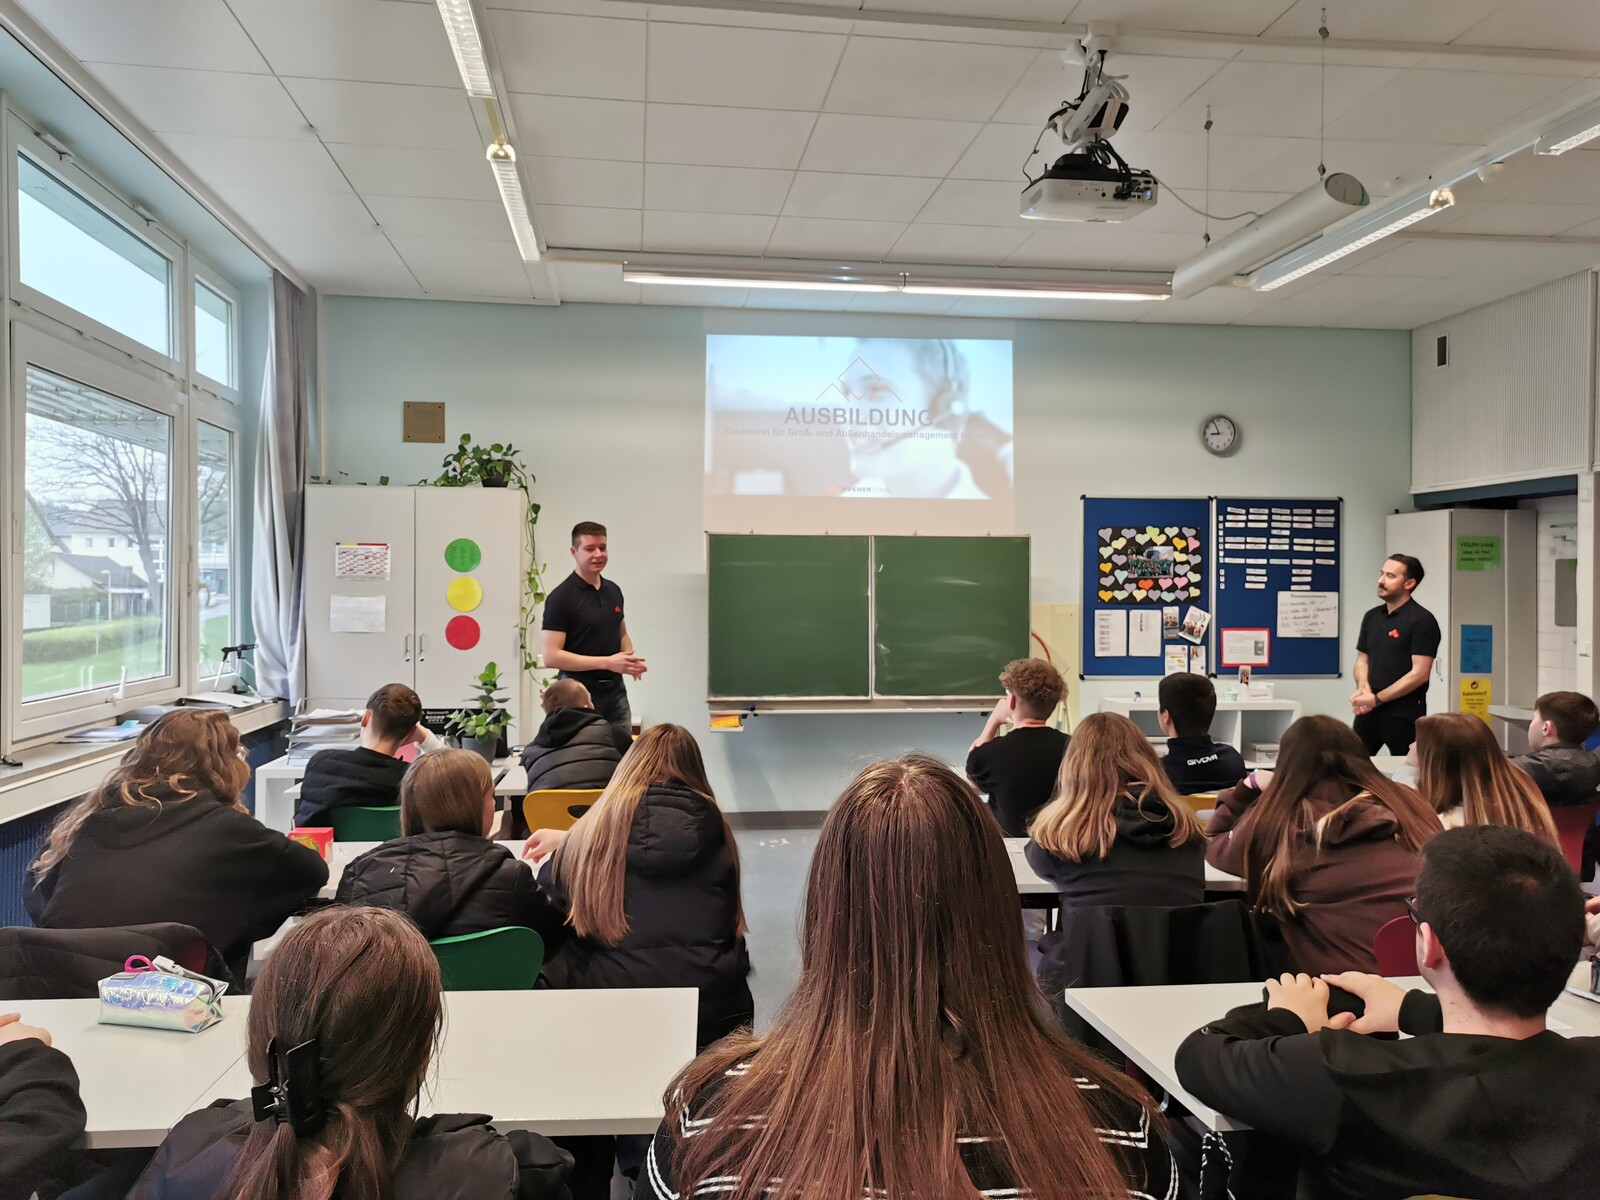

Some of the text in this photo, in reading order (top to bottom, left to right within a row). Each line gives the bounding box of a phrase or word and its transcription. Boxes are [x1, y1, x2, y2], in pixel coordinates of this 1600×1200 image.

[784, 407, 933, 427] AUSBILDUNG
[724, 426, 770, 437] Kaufmann
[772, 427, 785, 437] für
[787, 428, 813, 438] Groß-
[815, 428, 833, 438] und
[835, 428, 958, 441] Außenhandelsmanagement
[1186, 753, 1219, 766] GIVOVA
